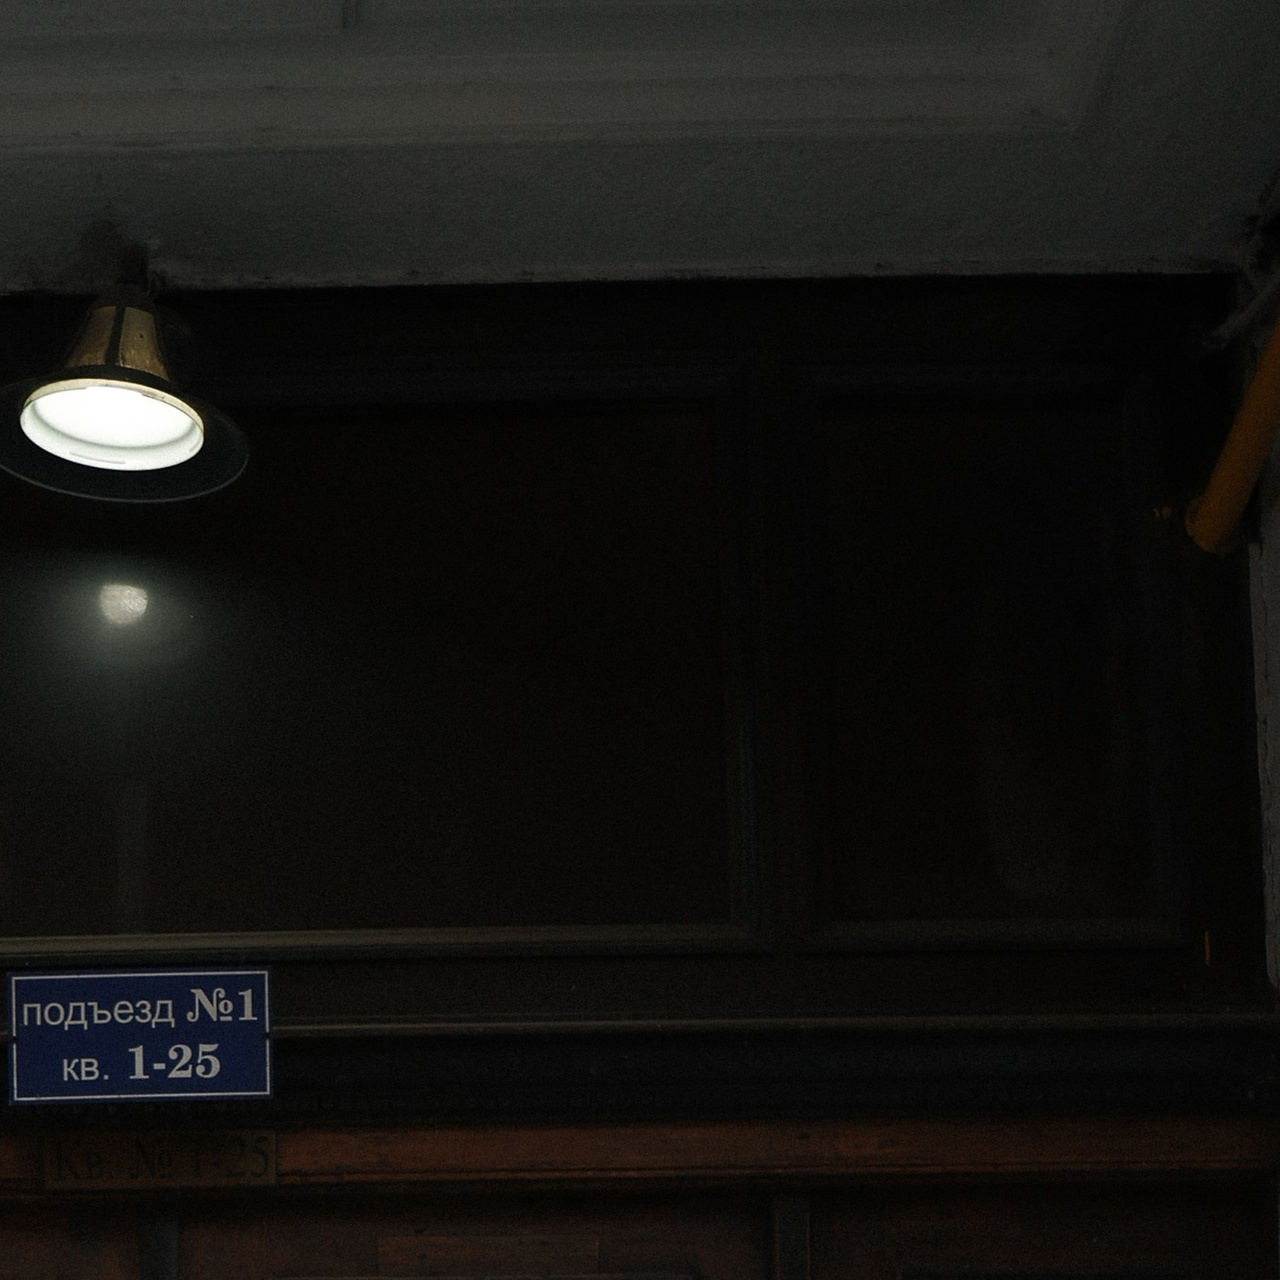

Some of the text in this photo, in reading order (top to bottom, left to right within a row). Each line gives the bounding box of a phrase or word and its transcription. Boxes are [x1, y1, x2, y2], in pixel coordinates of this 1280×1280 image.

[23, 987, 258, 1031] подъезд №1
[62, 1043, 221, 1081] кв. 1-25
